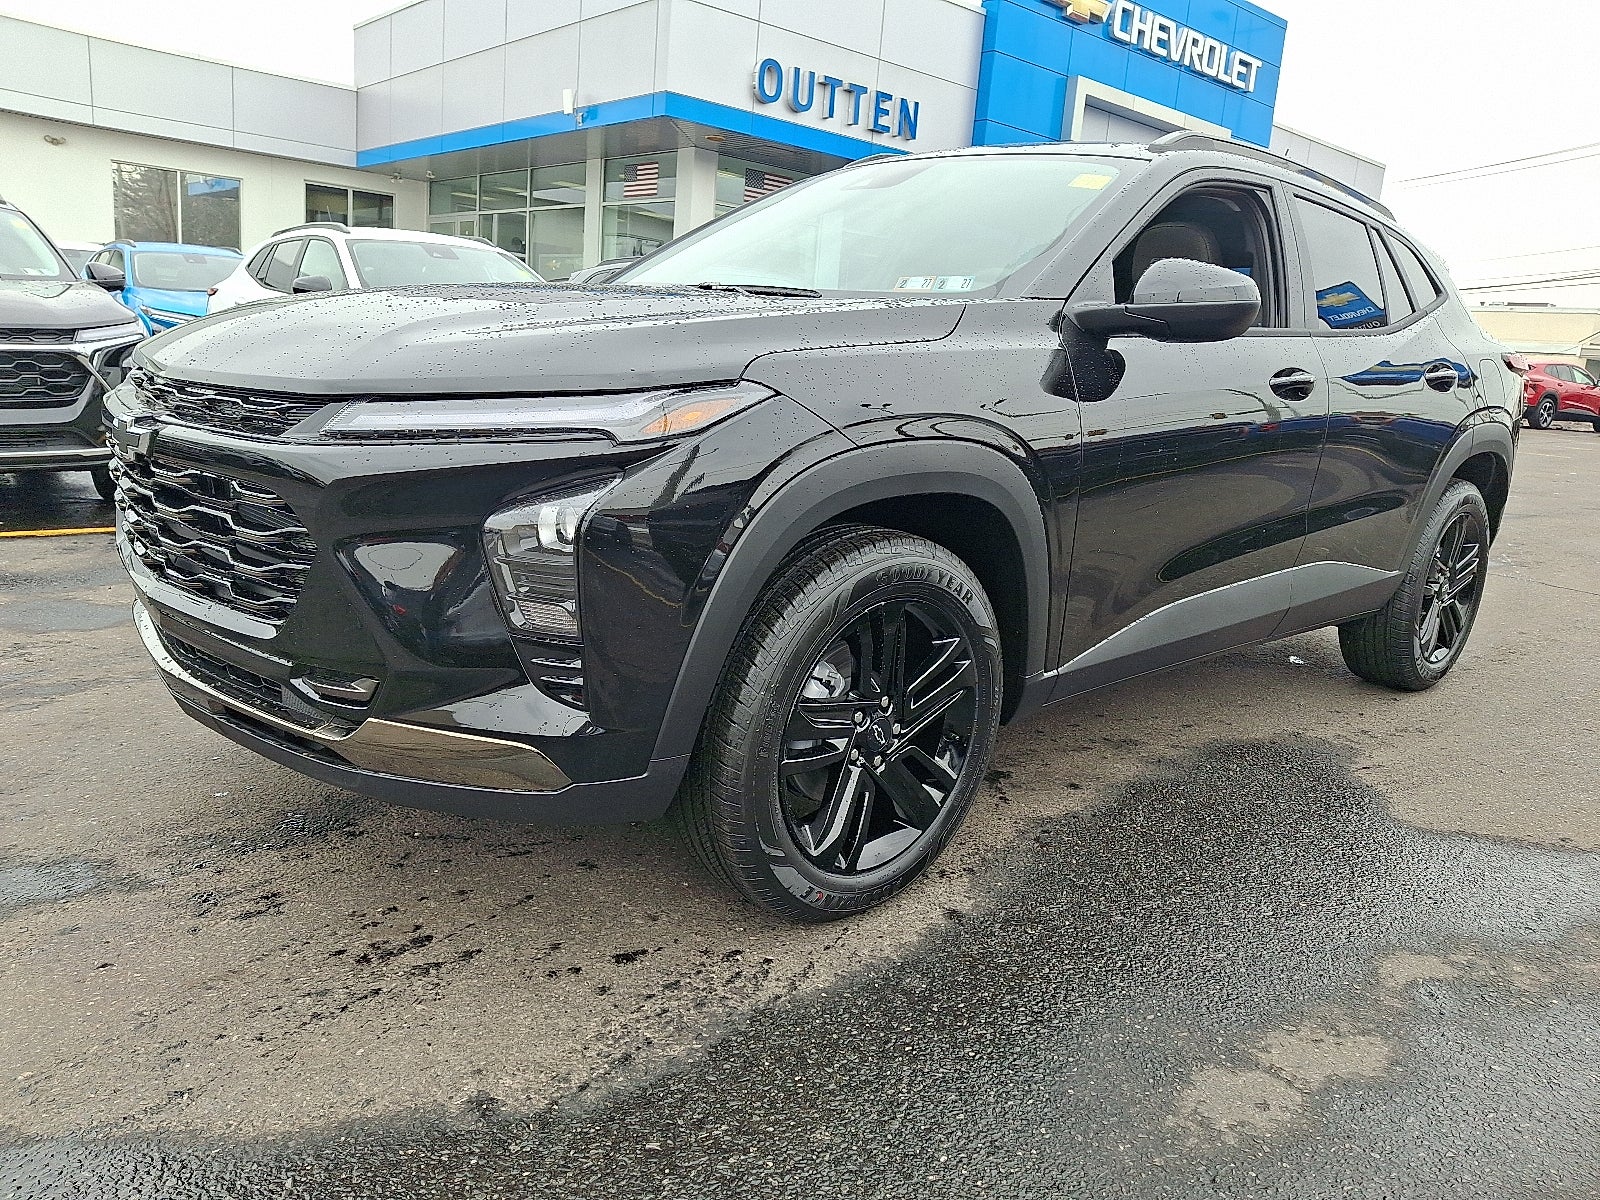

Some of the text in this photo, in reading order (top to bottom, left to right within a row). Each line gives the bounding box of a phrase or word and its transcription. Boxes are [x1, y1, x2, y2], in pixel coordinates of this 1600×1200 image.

[1111, 0, 1263, 93] CHEVROLET
[753, 58, 919, 140] OUTTEN
[937, 278, 972, 290] 2 27
